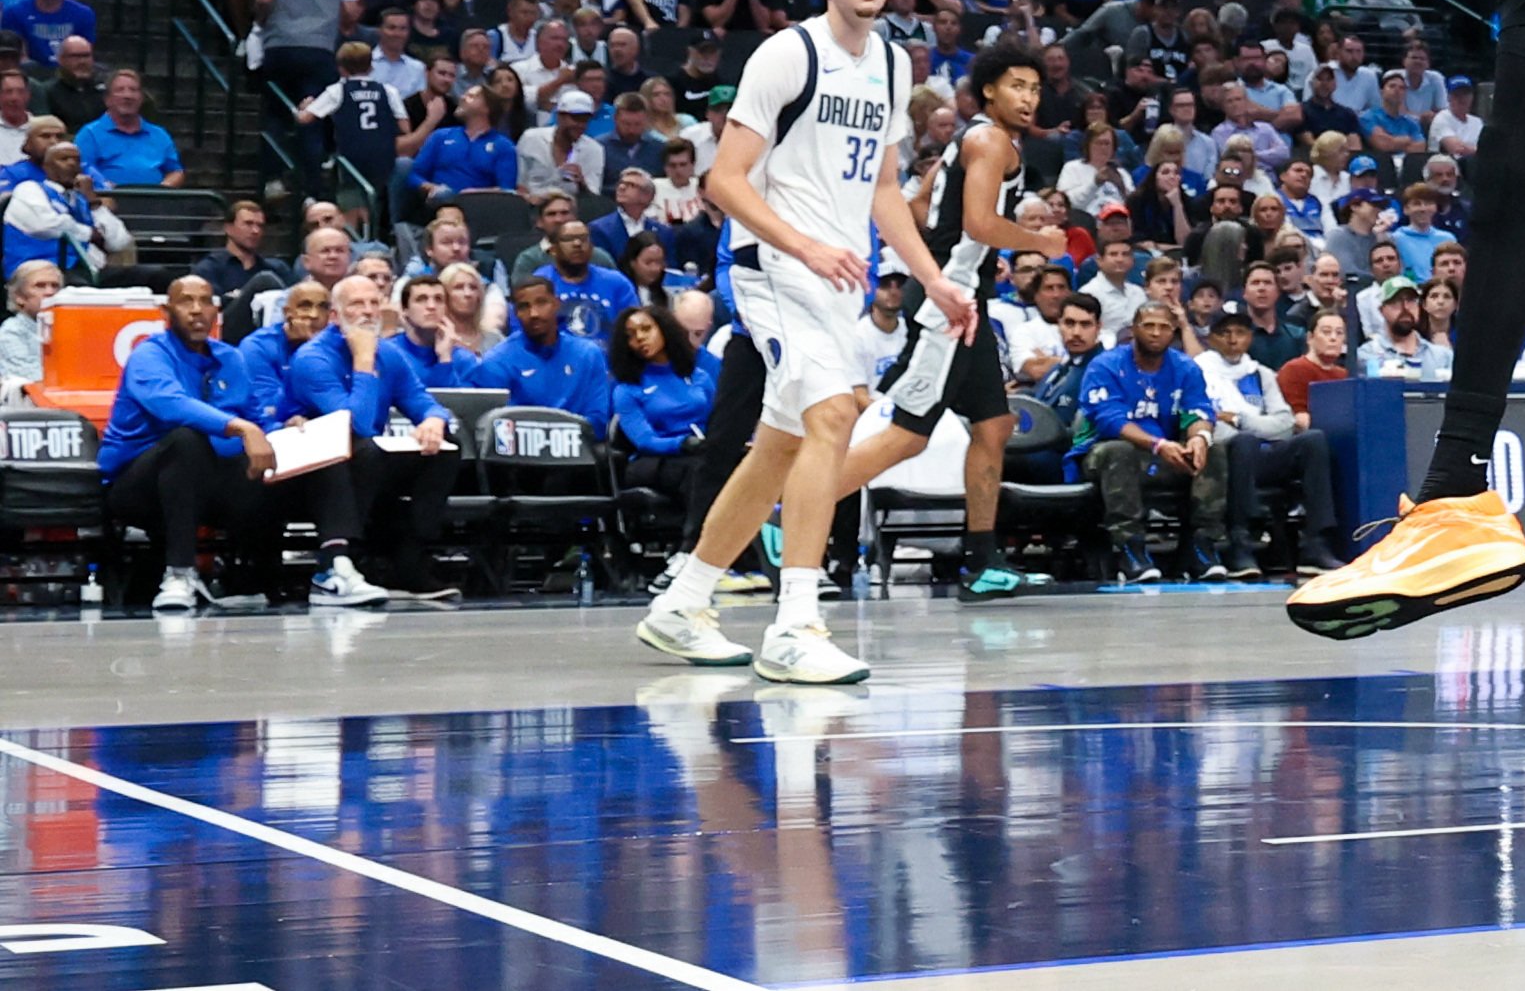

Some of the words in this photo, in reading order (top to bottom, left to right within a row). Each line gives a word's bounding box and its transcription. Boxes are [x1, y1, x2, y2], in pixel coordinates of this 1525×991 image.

[359, 102, 378, 130] 2
[817, 93, 885, 132] DALLAS
[841, 136, 878, 183] 32
[8, 427, 83, 459] TIP-OFF
[515, 427, 582, 458] TIP-OFF
